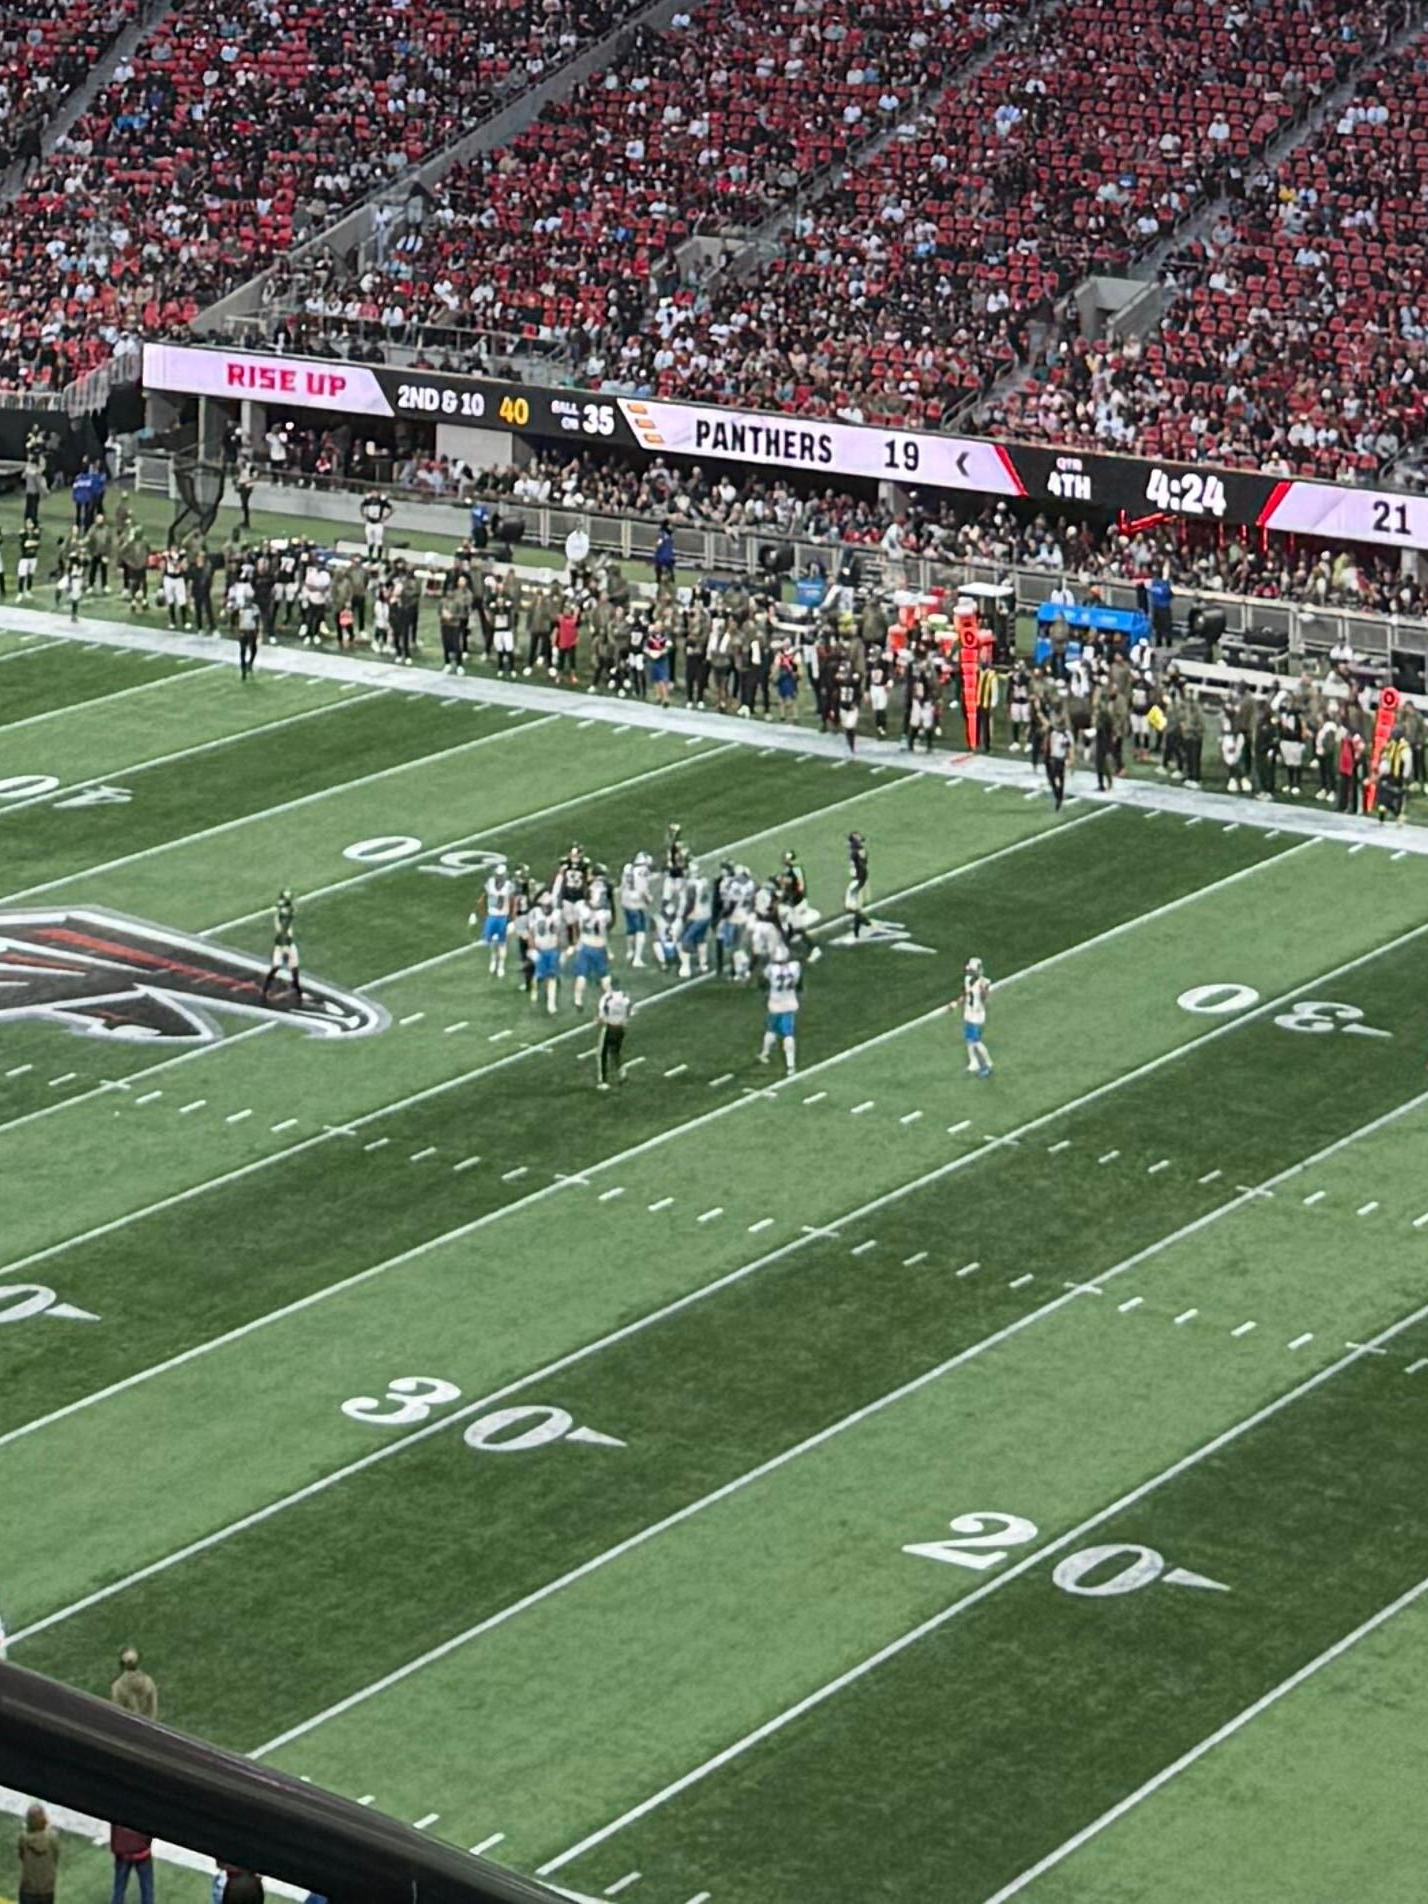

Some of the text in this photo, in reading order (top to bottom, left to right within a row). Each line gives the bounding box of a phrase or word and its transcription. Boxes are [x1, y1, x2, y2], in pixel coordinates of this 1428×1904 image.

[227, 363, 346, 397] RISE UP
[398, 386, 439, 411] 2ND
[462, 394, 484, 416] 10
[500, 397, 528, 424] 40
[583, 404, 614, 435] 35
[696, 419, 919, 470] PANTHERS 19
[1047, 469, 1226, 517] 4TH 4:24
[1372, 500, 1411, 535] 21
[341, 1375, 573, 1451] 30
[902, 1511, 1165, 1596] 20
